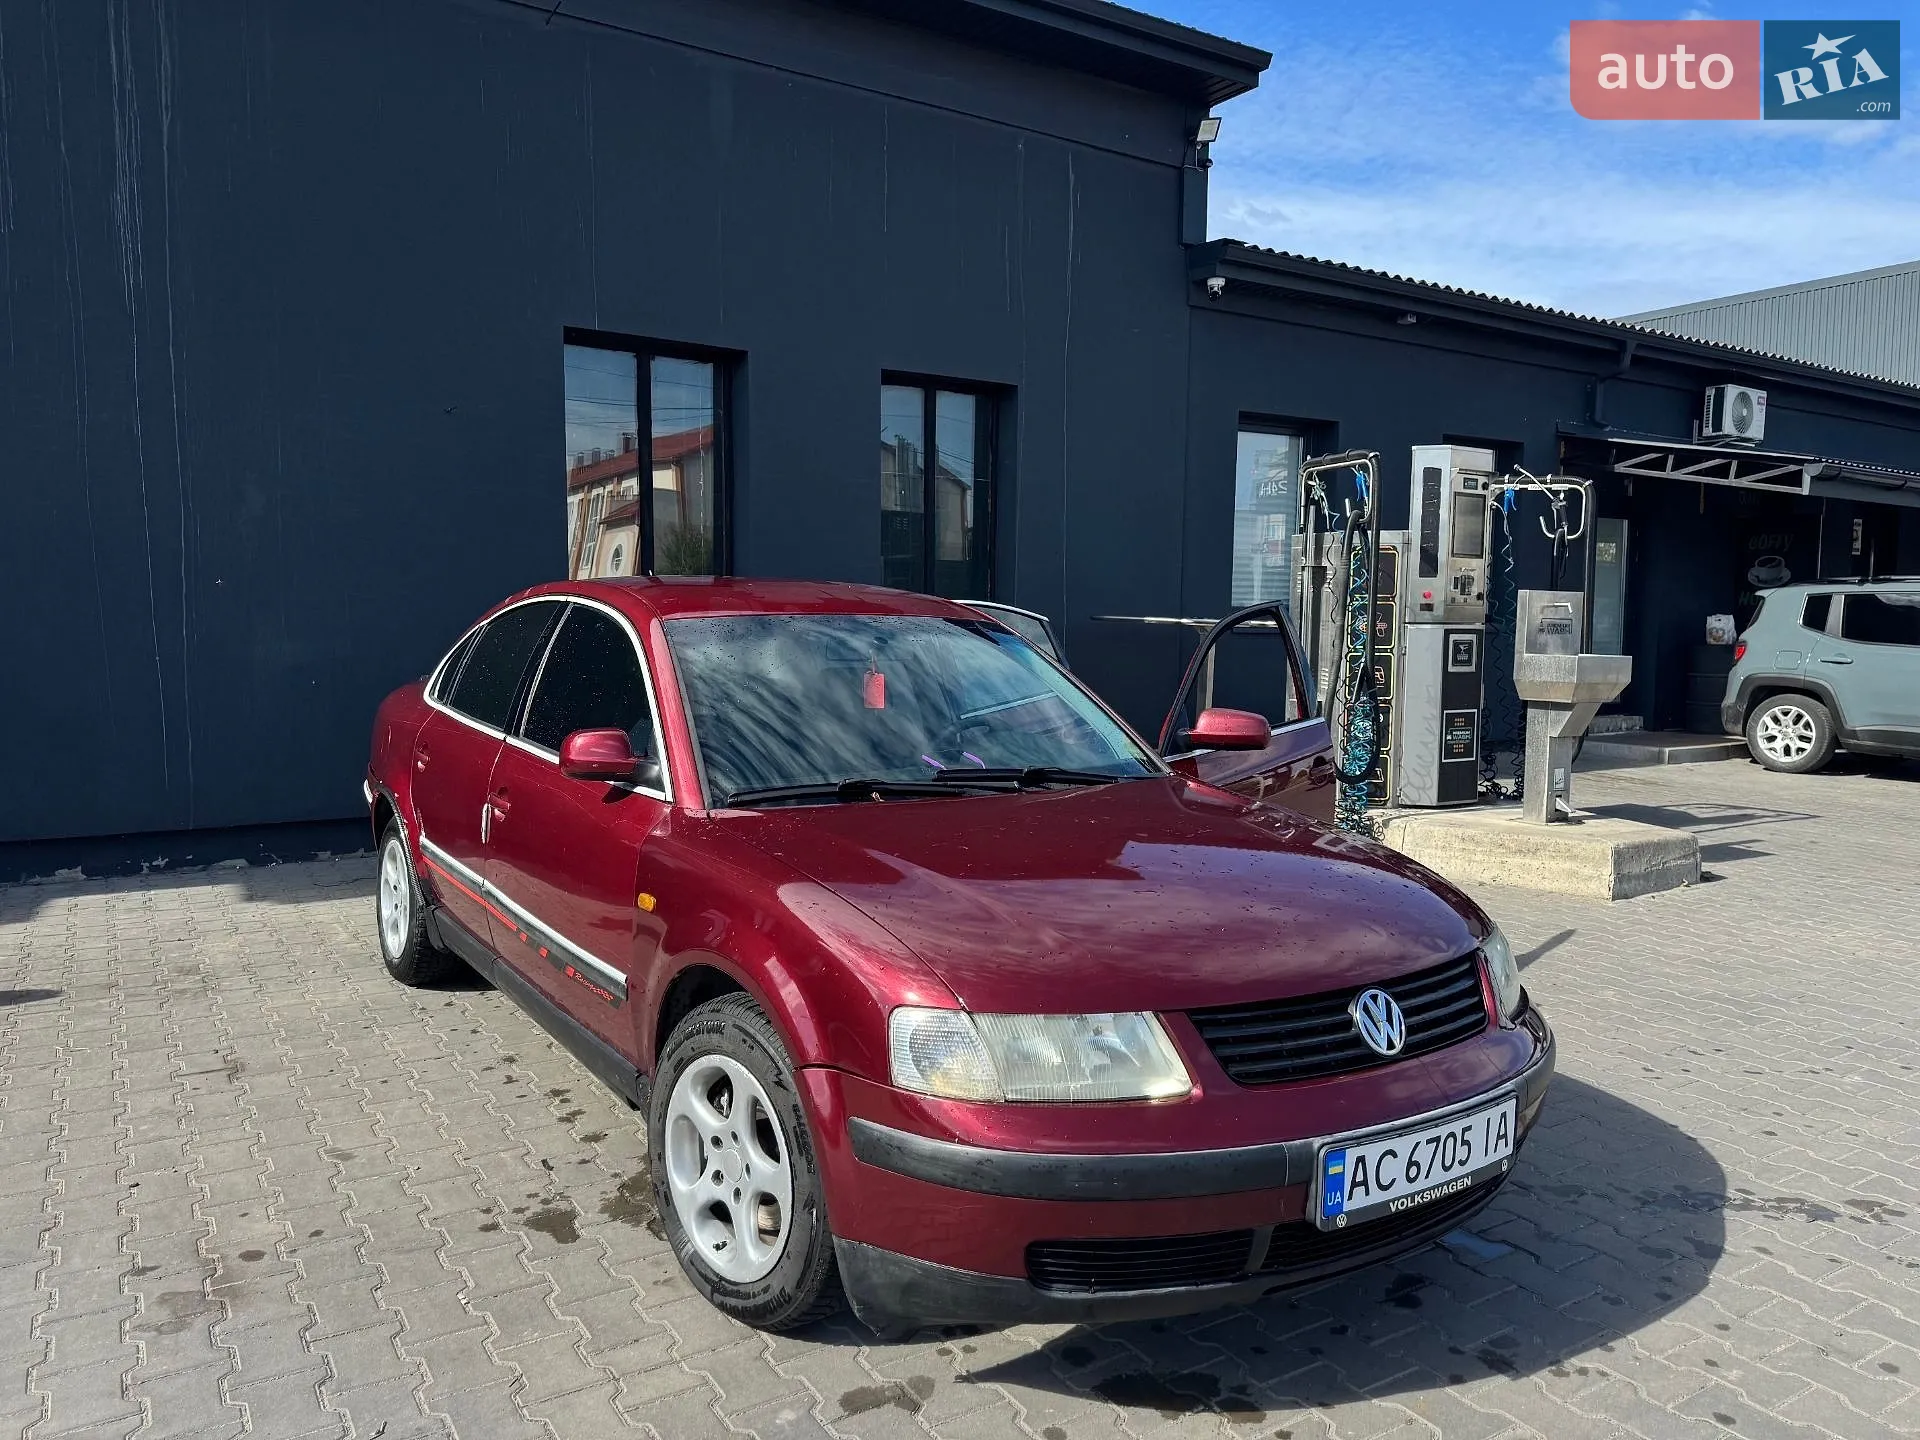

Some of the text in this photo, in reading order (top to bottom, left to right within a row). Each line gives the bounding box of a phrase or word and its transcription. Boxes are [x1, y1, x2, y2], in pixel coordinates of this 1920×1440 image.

[1347, 1110, 1510, 1202] AC 6705 IA
[1327, 1191, 1342, 1206] UA
[1389, 1175, 1472, 1212] VOLKSWAGEN
